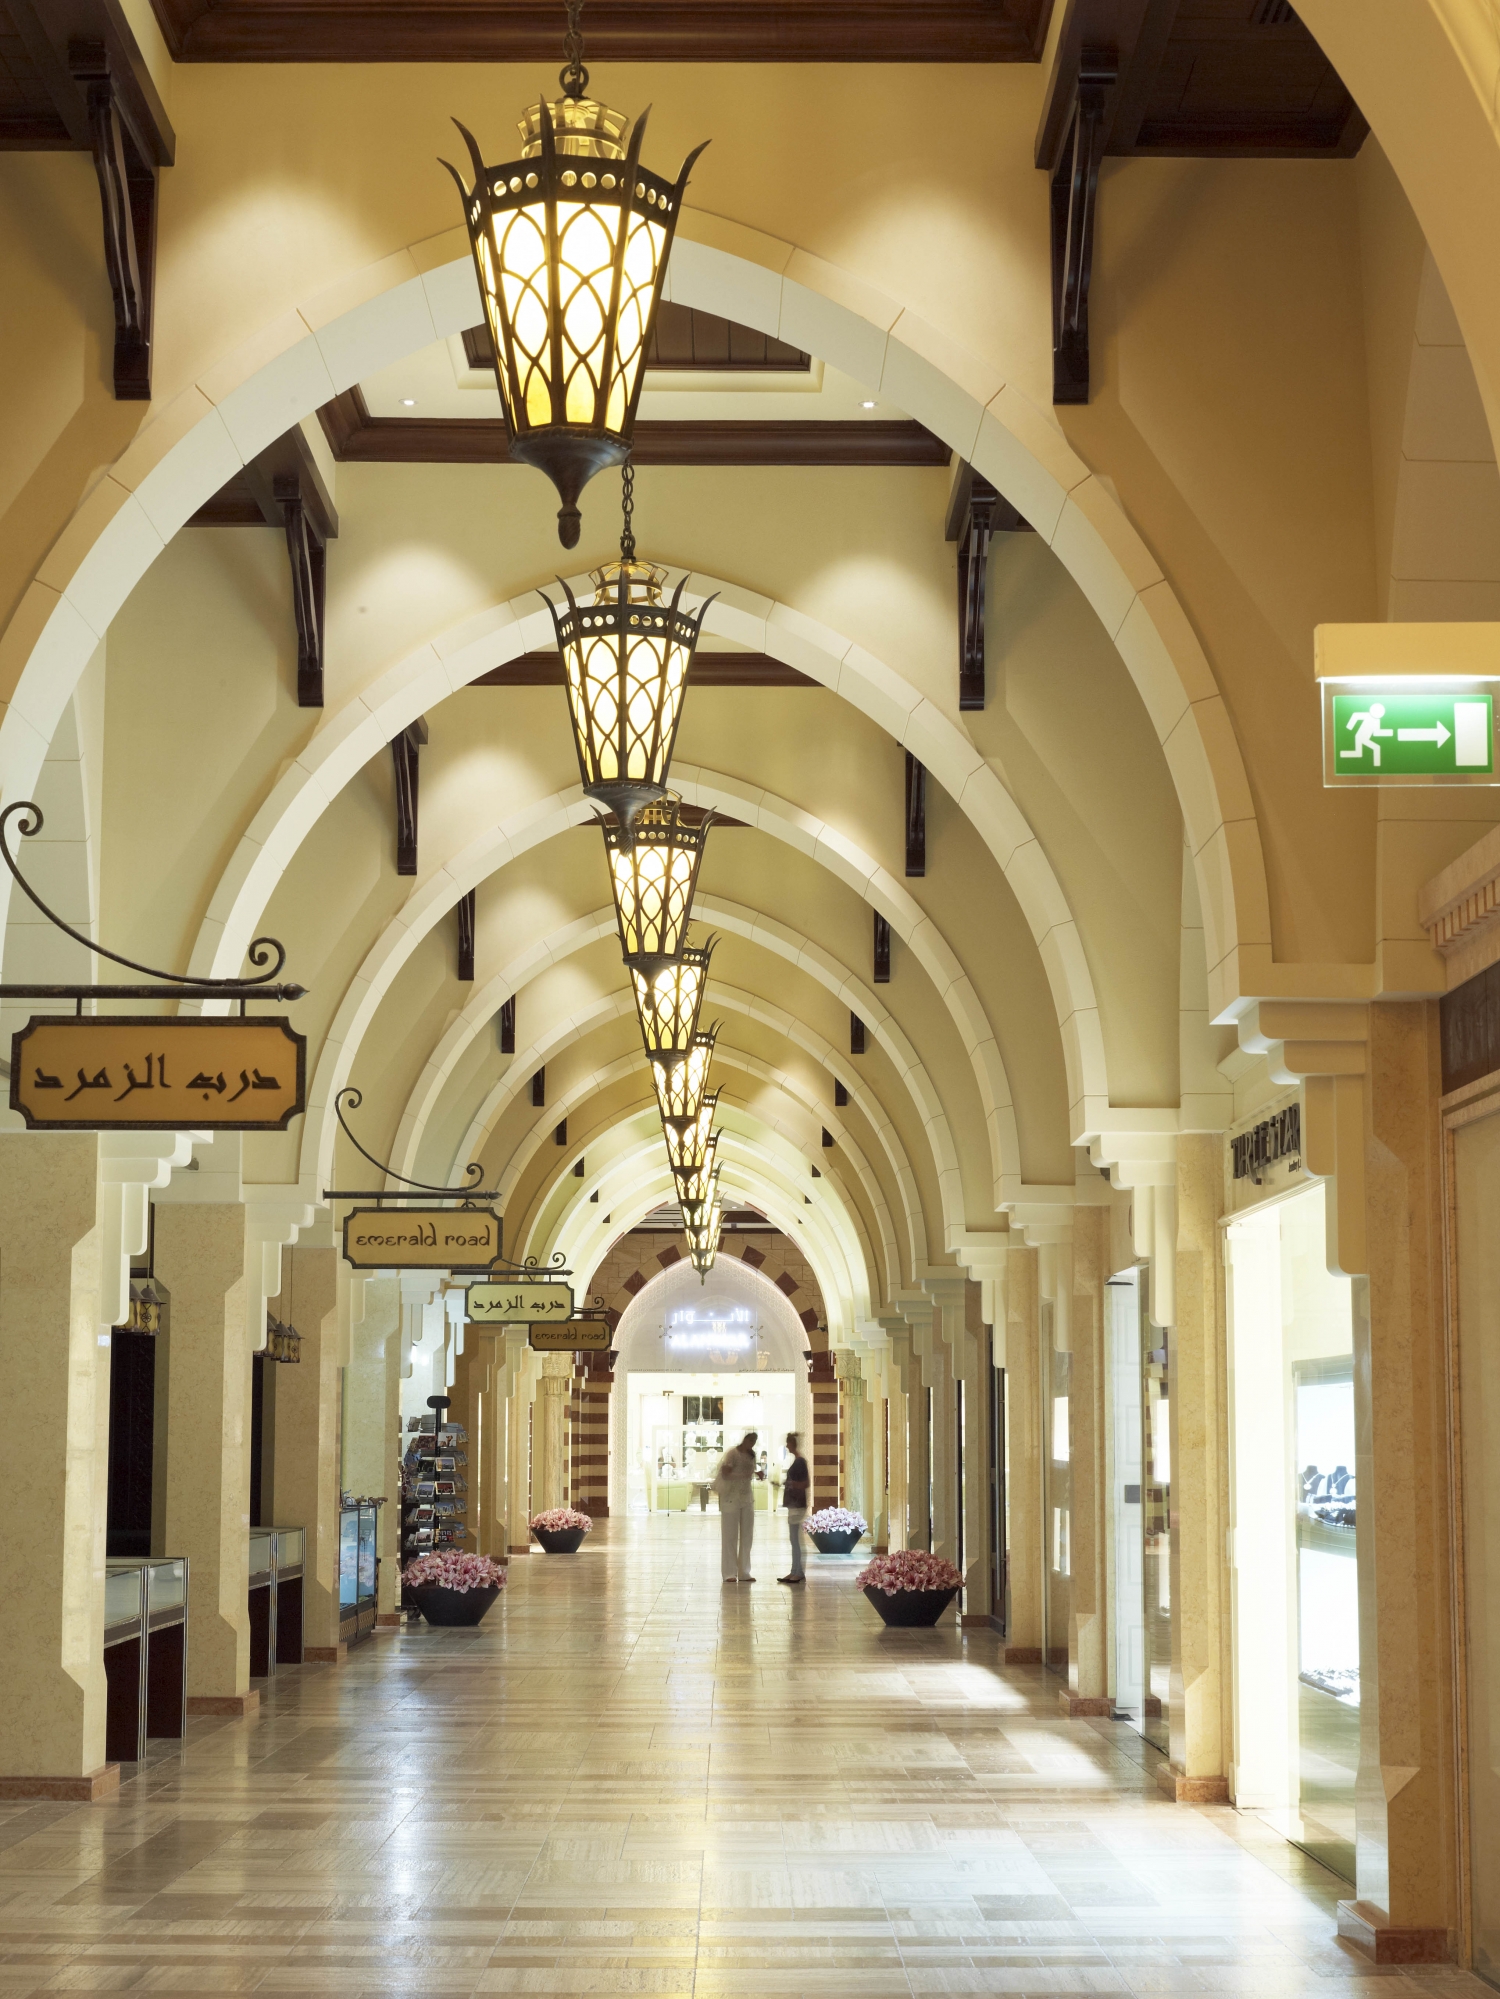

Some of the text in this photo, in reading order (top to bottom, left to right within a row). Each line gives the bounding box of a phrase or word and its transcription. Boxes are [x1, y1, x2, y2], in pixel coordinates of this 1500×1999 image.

[34, 1052, 282, 1102] درب الزمرد
[356, 1222, 491, 1247] emerald road
[473, 1294, 566, 1313] درب الزمرد
[535, 1326, 606, 1340] emerald road
